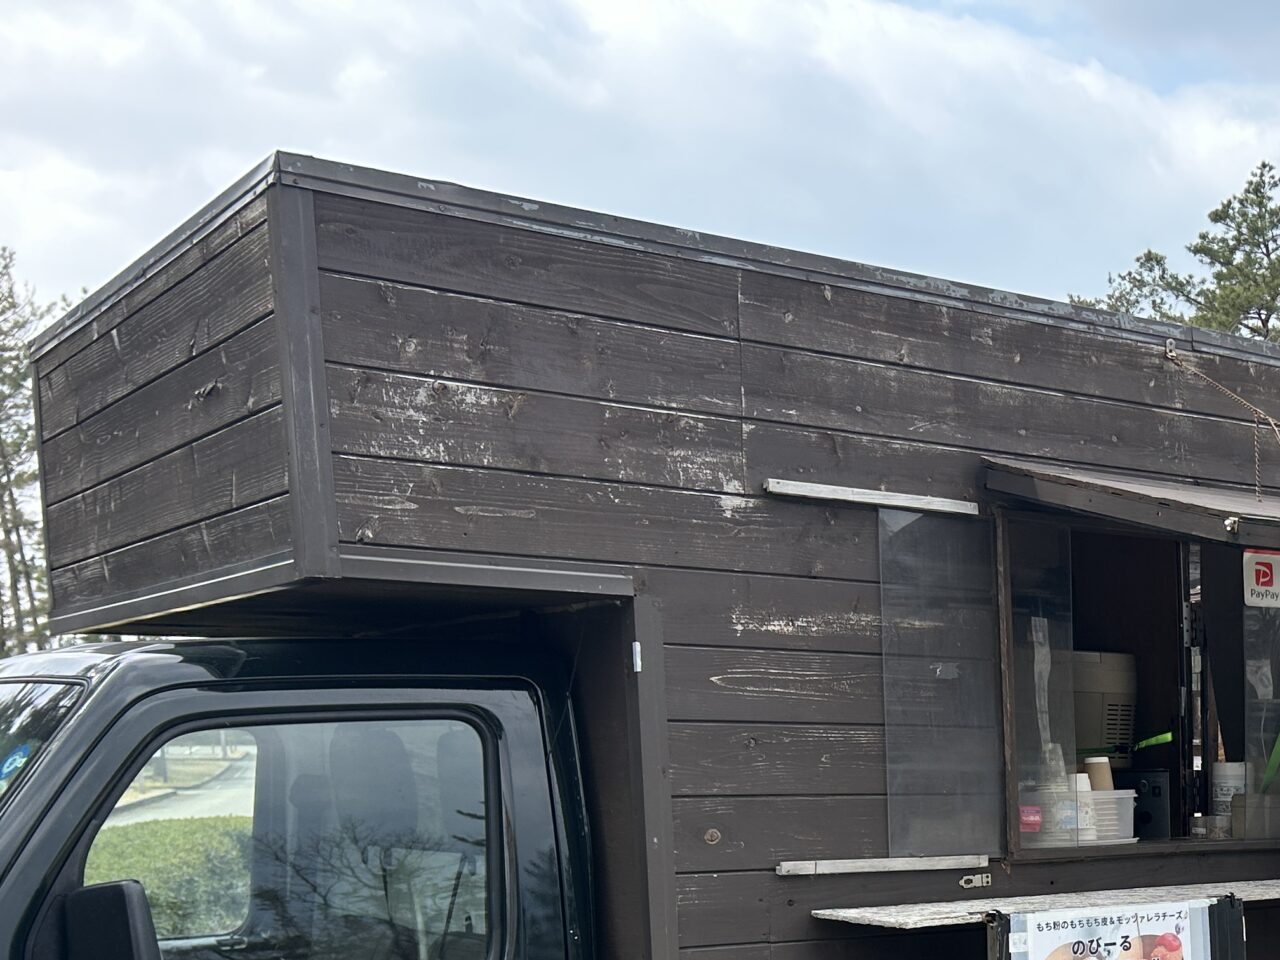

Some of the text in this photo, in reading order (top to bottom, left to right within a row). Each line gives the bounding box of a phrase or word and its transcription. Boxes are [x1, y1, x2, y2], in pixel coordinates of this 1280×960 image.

[1250, 588, 1280, 601] PayPay
[1072, 935, 1132, 956] のびーる
